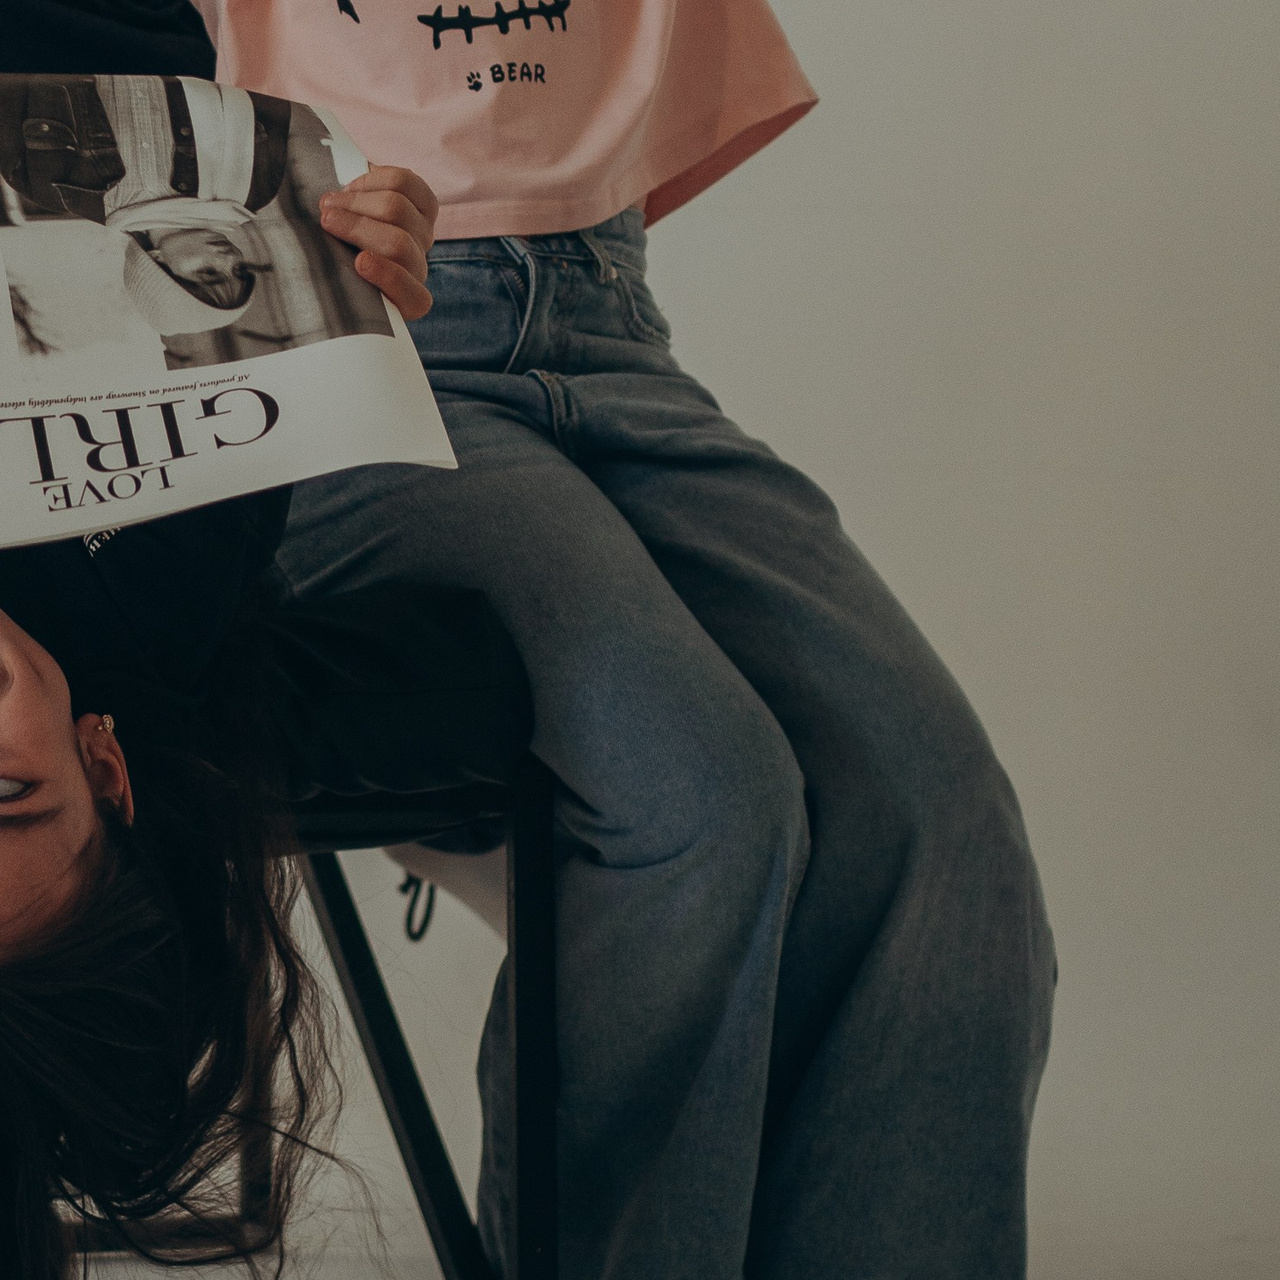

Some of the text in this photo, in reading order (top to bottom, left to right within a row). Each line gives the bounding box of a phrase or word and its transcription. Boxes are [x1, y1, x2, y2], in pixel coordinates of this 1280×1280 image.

[489, 61, 546, 84] BEAR
[198, 374, 236, 390] products
[237, 373, 251, 383] All
[105, 390, 147, 402] Sinowrap
[161, 381, 197, 396] featured
[89, 394, 104, 403] are
[41, 464, 176, 513] LOVE
